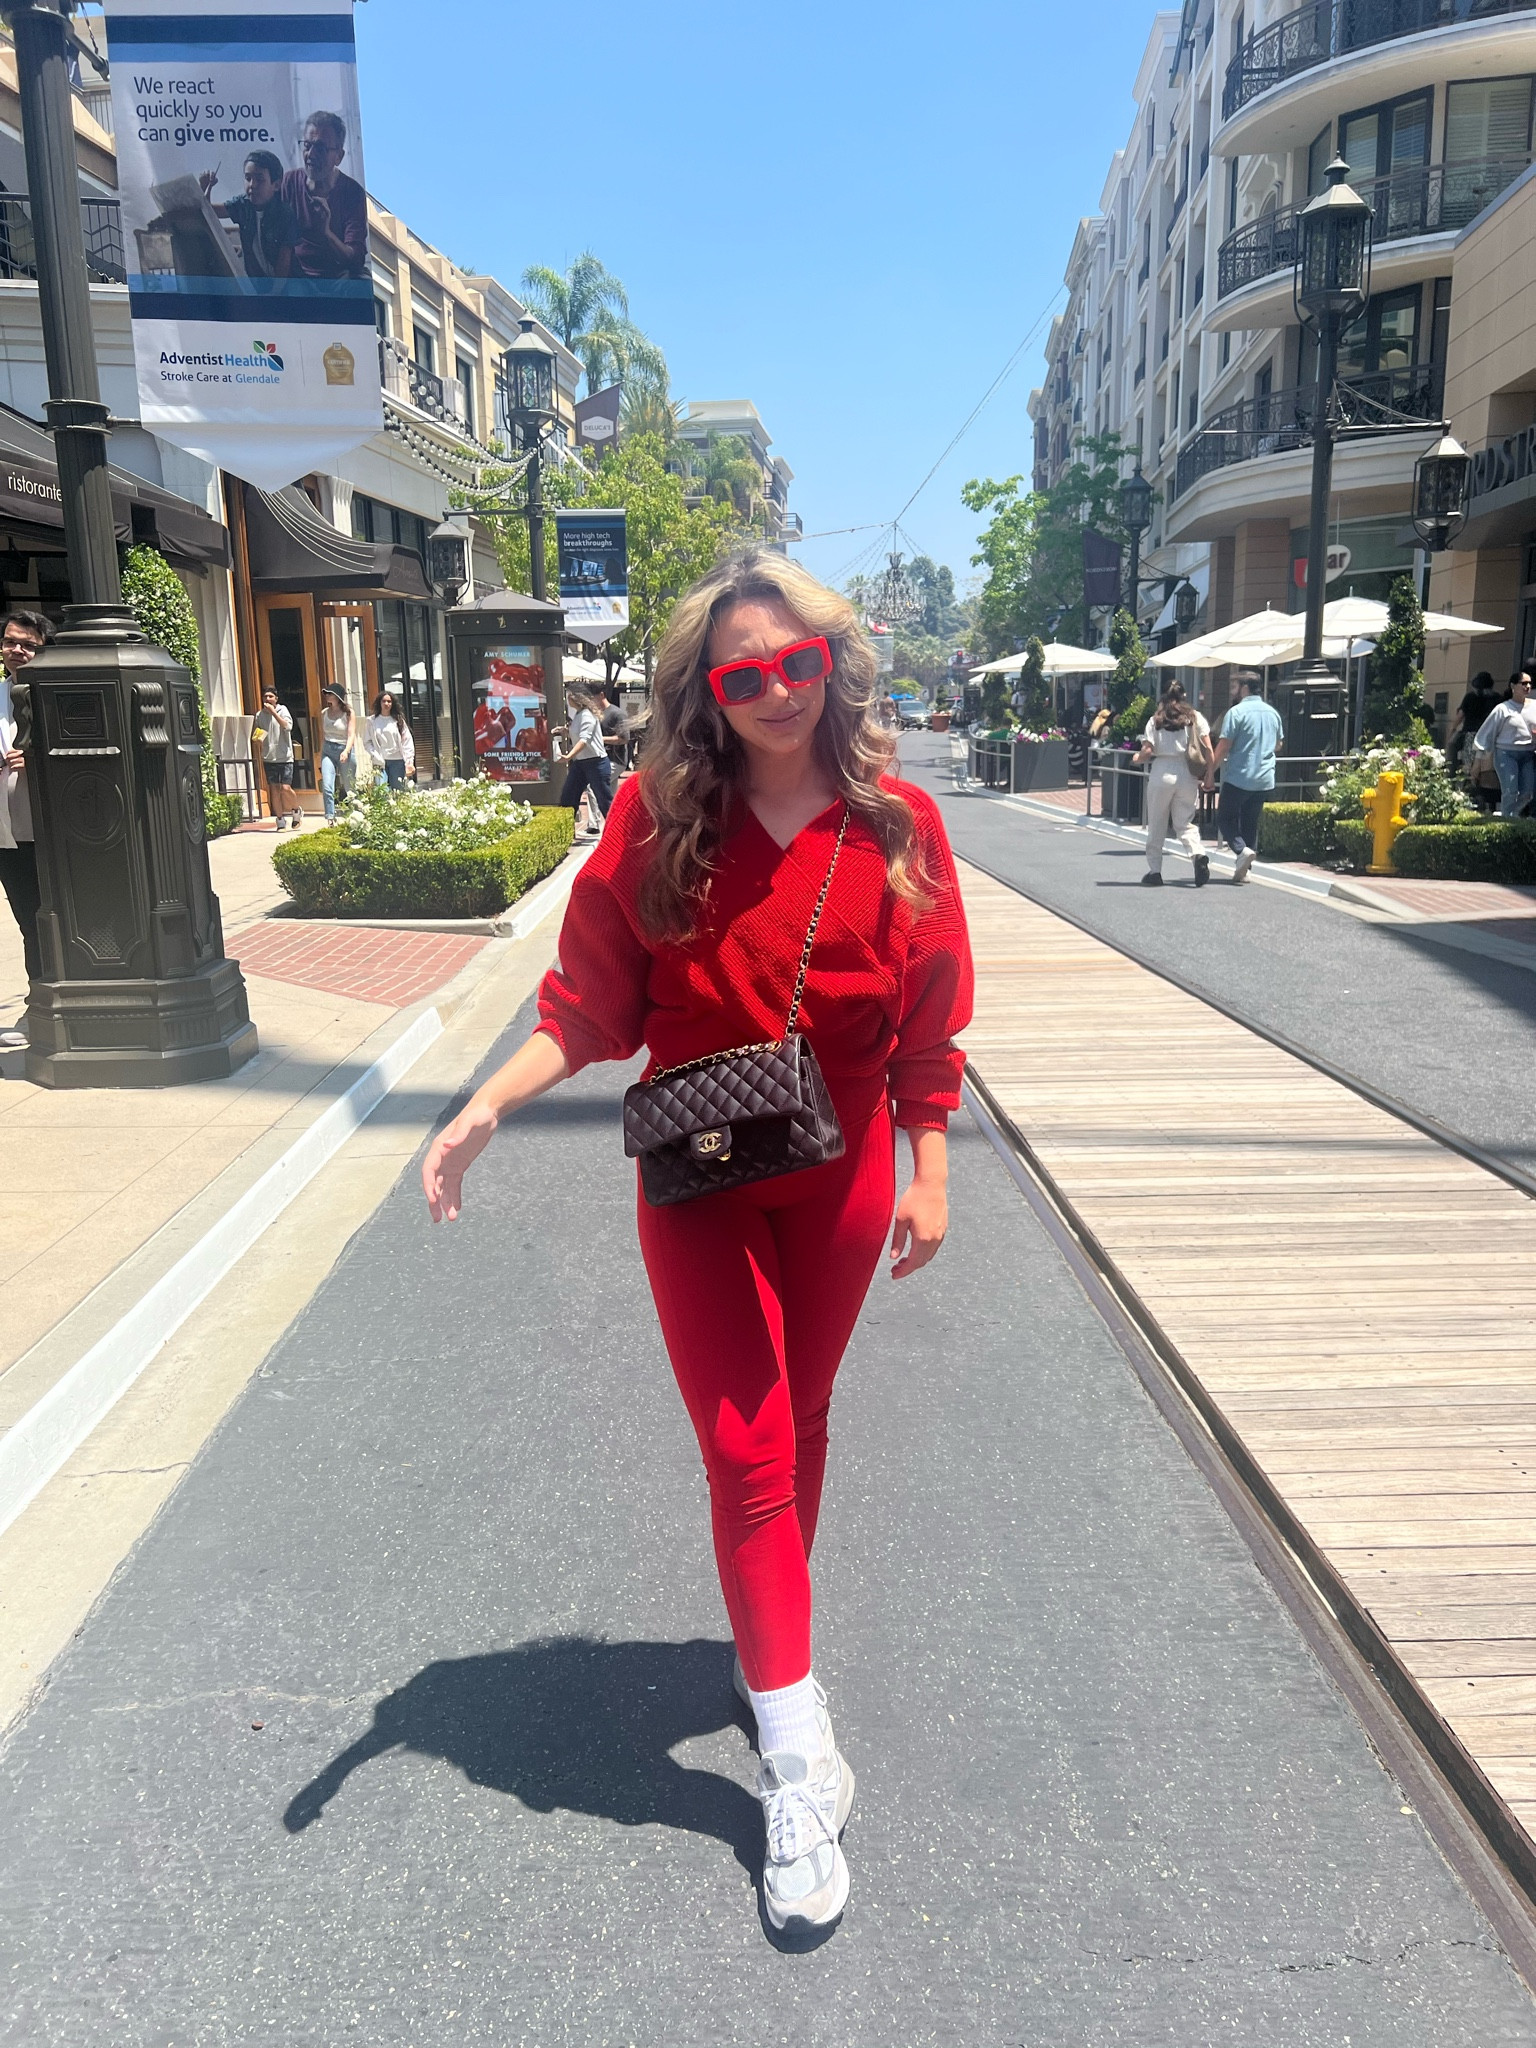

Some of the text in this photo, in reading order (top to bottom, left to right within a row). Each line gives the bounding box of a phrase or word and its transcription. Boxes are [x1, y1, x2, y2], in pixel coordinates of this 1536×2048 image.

[134, 76, 215, 95] We react
[136, 98, 262, 123] quickly so you
[138, 123, 275, 146] can give more.
[161, 371, 193, 381] Stroke
[196, 372, 219, 382] Care
[235, 373, 280, 384] Glendale
[1469, 424, 1536, 499] RDSTR
[8, 471, 62, 502] ristorante
[581, 532, 595, 540] high
